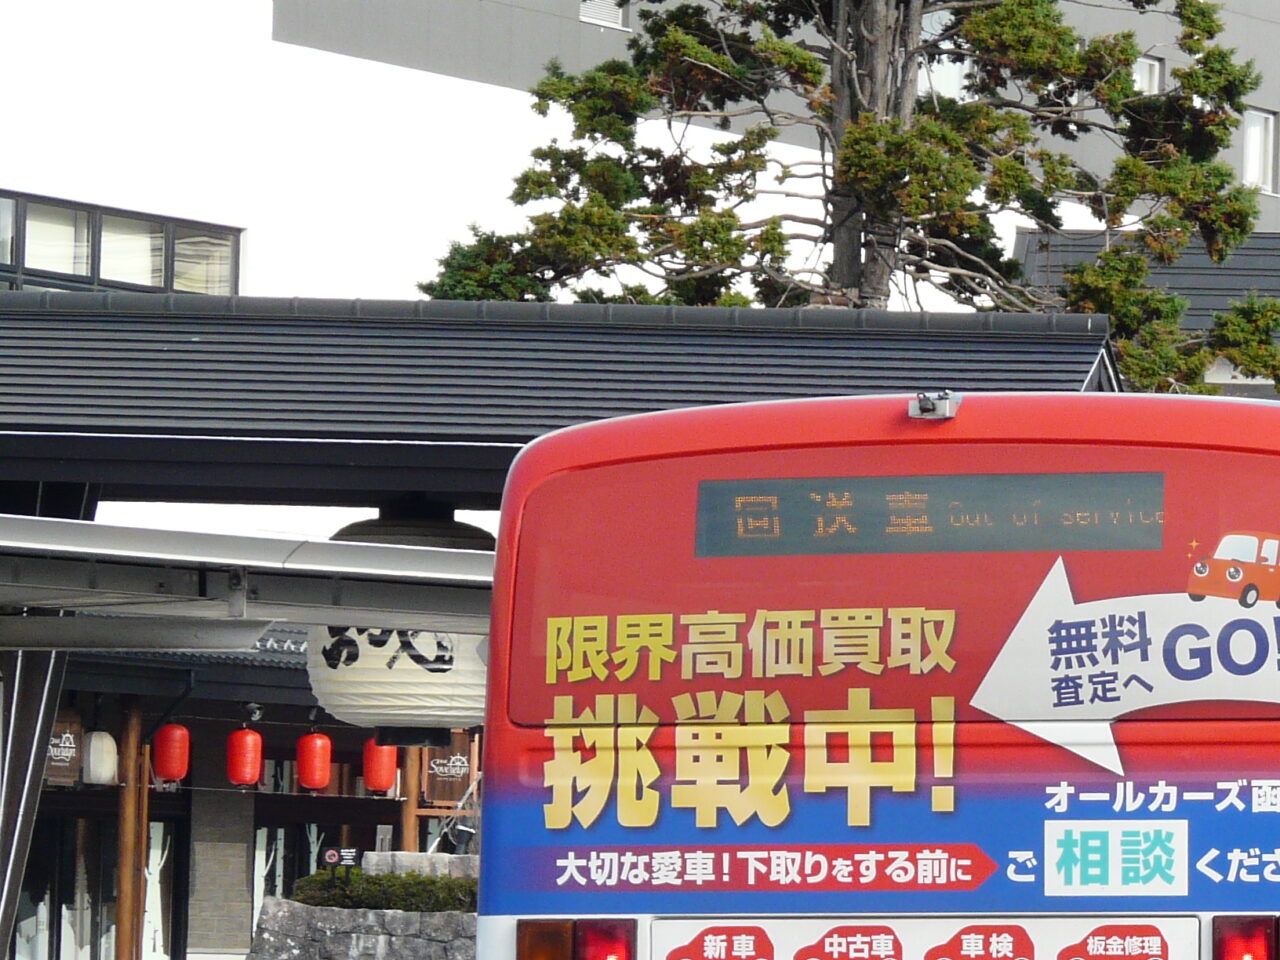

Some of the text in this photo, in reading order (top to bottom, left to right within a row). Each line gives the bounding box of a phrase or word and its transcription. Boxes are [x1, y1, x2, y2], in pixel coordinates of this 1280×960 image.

[545, 606, 958, 684] 限界高価買取
[1048, 611, 1152, 671] 無料
[1051, 671, 1154, 708] 査定へ
[543, 688, 956, 829] 挑戦中!
[703, 935, 756, 960] 新車
[824, 934, 895, 960] 中古車
[960, 933, 1014, 959] 車検
[1086, 935, 1162, 957] 板金修理
